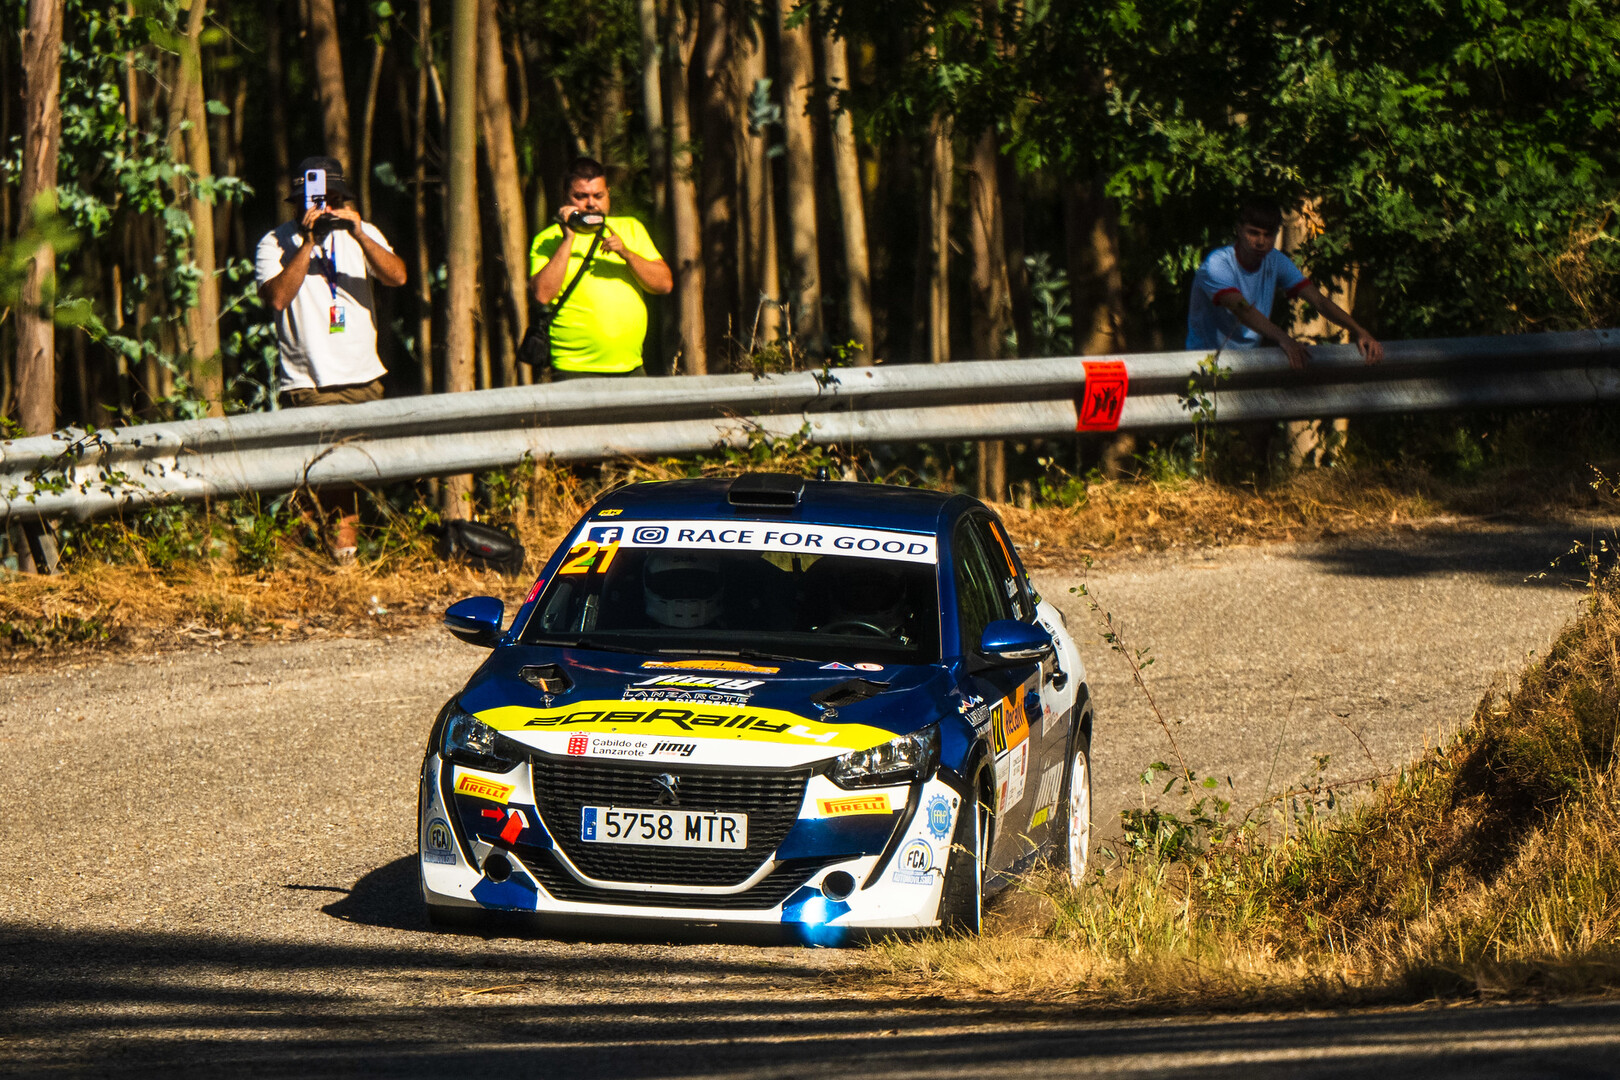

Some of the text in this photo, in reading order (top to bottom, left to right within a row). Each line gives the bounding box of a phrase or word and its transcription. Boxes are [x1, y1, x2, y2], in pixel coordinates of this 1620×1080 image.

[677, 529, 929, 556] RACE FOR GOOD
[558, 540, 621, 575] 21
[623, 690, 749, 703] LANZAROTE
[993, 707, 1004, 753] 21
[592, 738, 632, 748] Cabildo
[592, 747, 645, 757] Lanzarote
[648, 740, 698, 757] jimy
[459, 776, 510, 799] PIRELLI
[824, 796, 886, 814] PIRELLI
[587, 827, 593, 836] E
[605, 811, 737, 843] 5758 MTR
[432, 828, 448, 849] FCA
[906, 849, 926, 869] FCA
